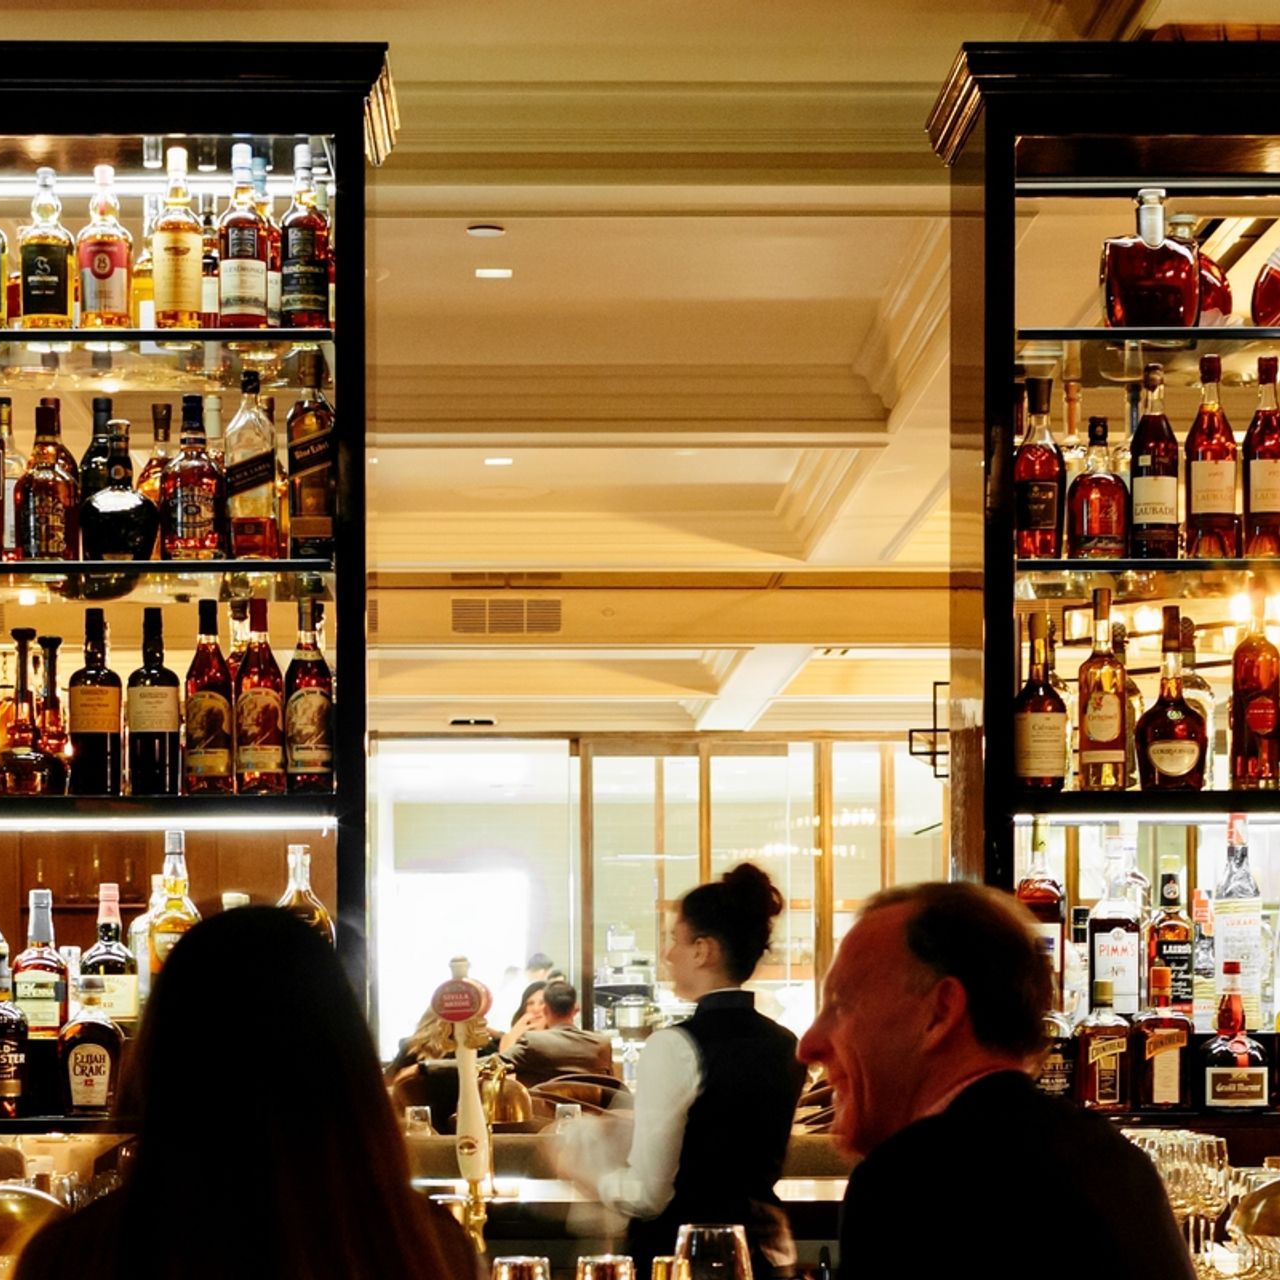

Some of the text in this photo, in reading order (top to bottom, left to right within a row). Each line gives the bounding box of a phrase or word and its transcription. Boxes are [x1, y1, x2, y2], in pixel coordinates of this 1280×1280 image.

[1098, 944, 1135, 957] PIMM'S
[74, 1053, 106, 1064] ELIJAH
[73, 1064, 106, 1077] CRAIG
